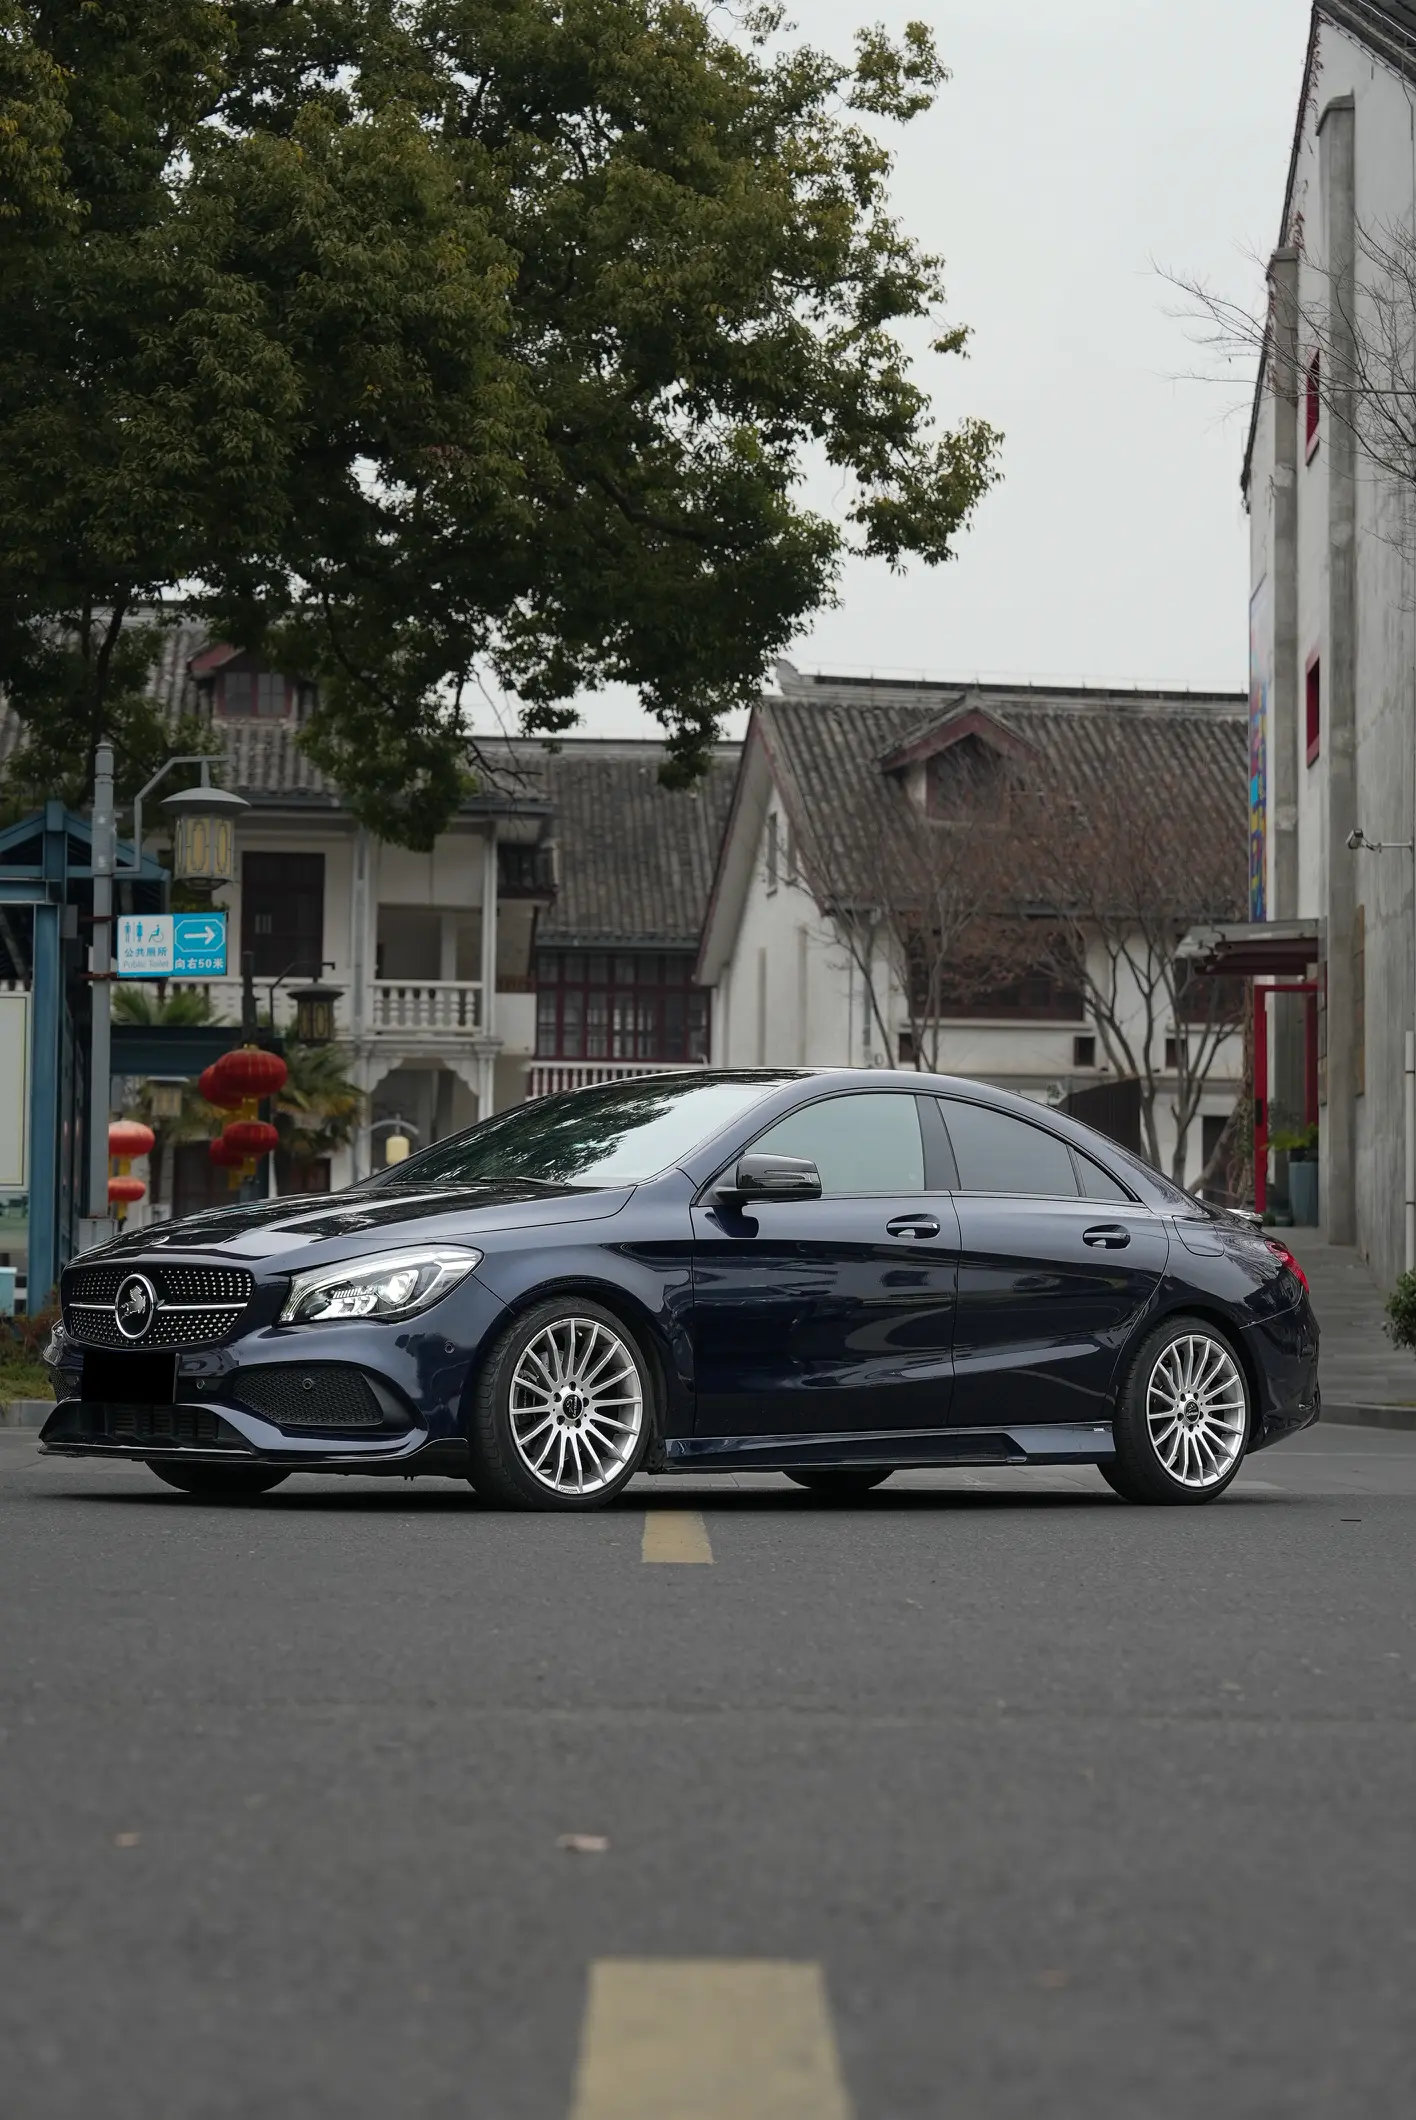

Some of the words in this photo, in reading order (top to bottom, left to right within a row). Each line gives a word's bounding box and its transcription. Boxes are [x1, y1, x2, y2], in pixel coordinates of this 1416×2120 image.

[124, 947, 167, 957] 公共厕所
[175, 958, 224, 969] 向右50米
